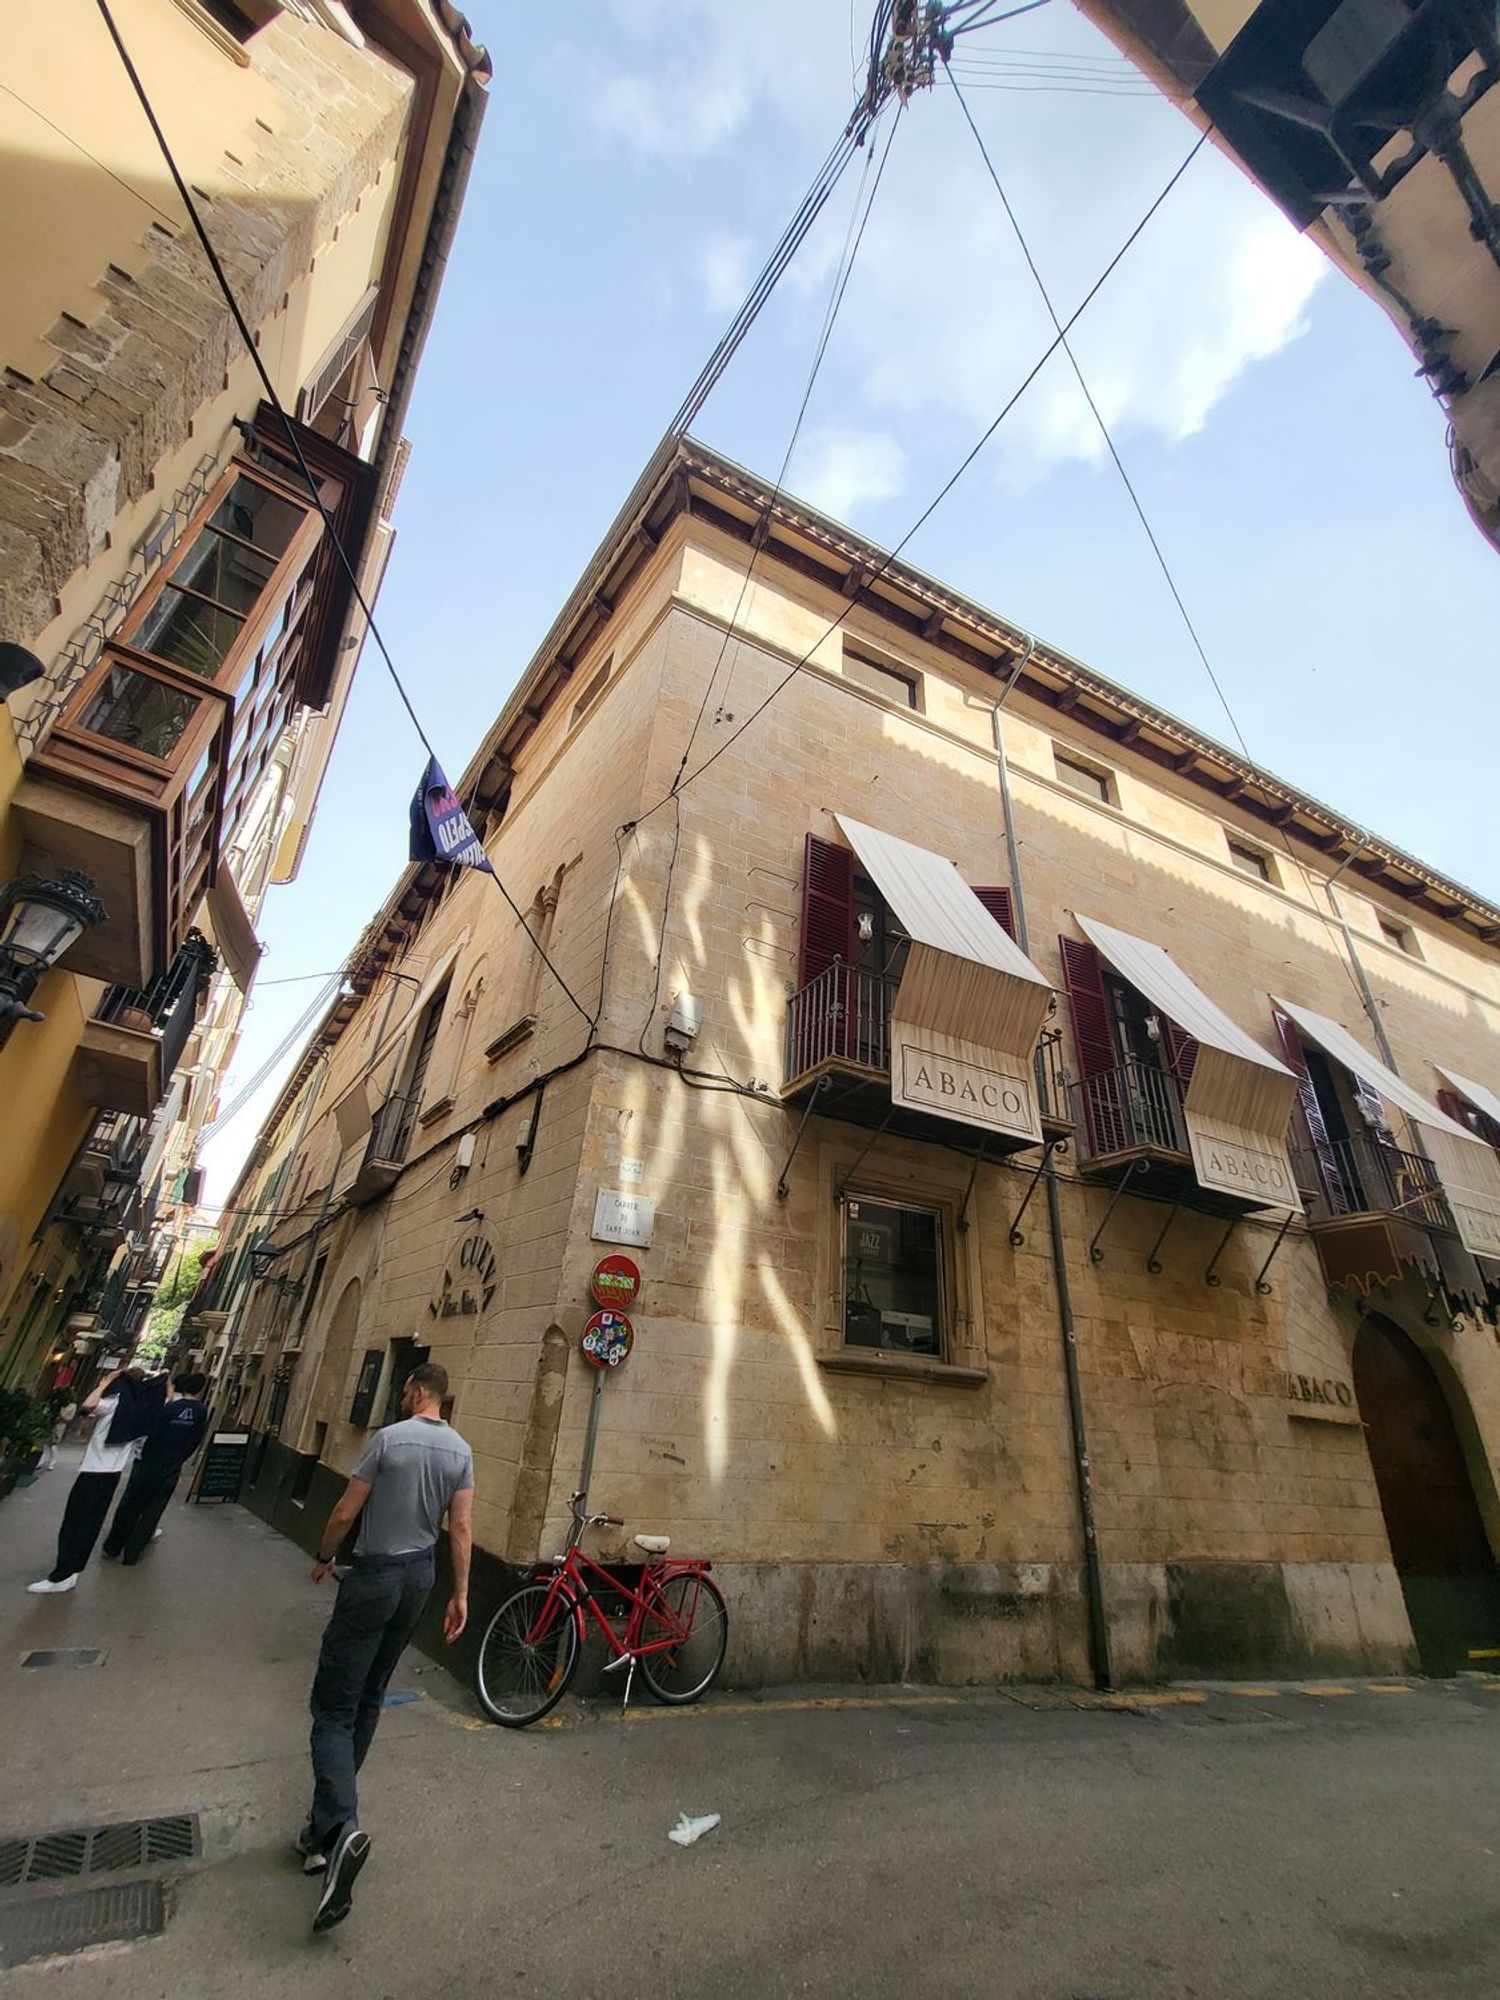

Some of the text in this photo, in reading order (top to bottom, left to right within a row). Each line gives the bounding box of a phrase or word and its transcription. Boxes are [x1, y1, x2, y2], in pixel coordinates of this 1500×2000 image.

[914, 1066, 1021, 1114] ABACO
[1210, 1151, 1284, 1189] ABACO
[860, 1231, 880, 1249] JAZZ
[1286, 1373, 1352, 1408] ABACO
